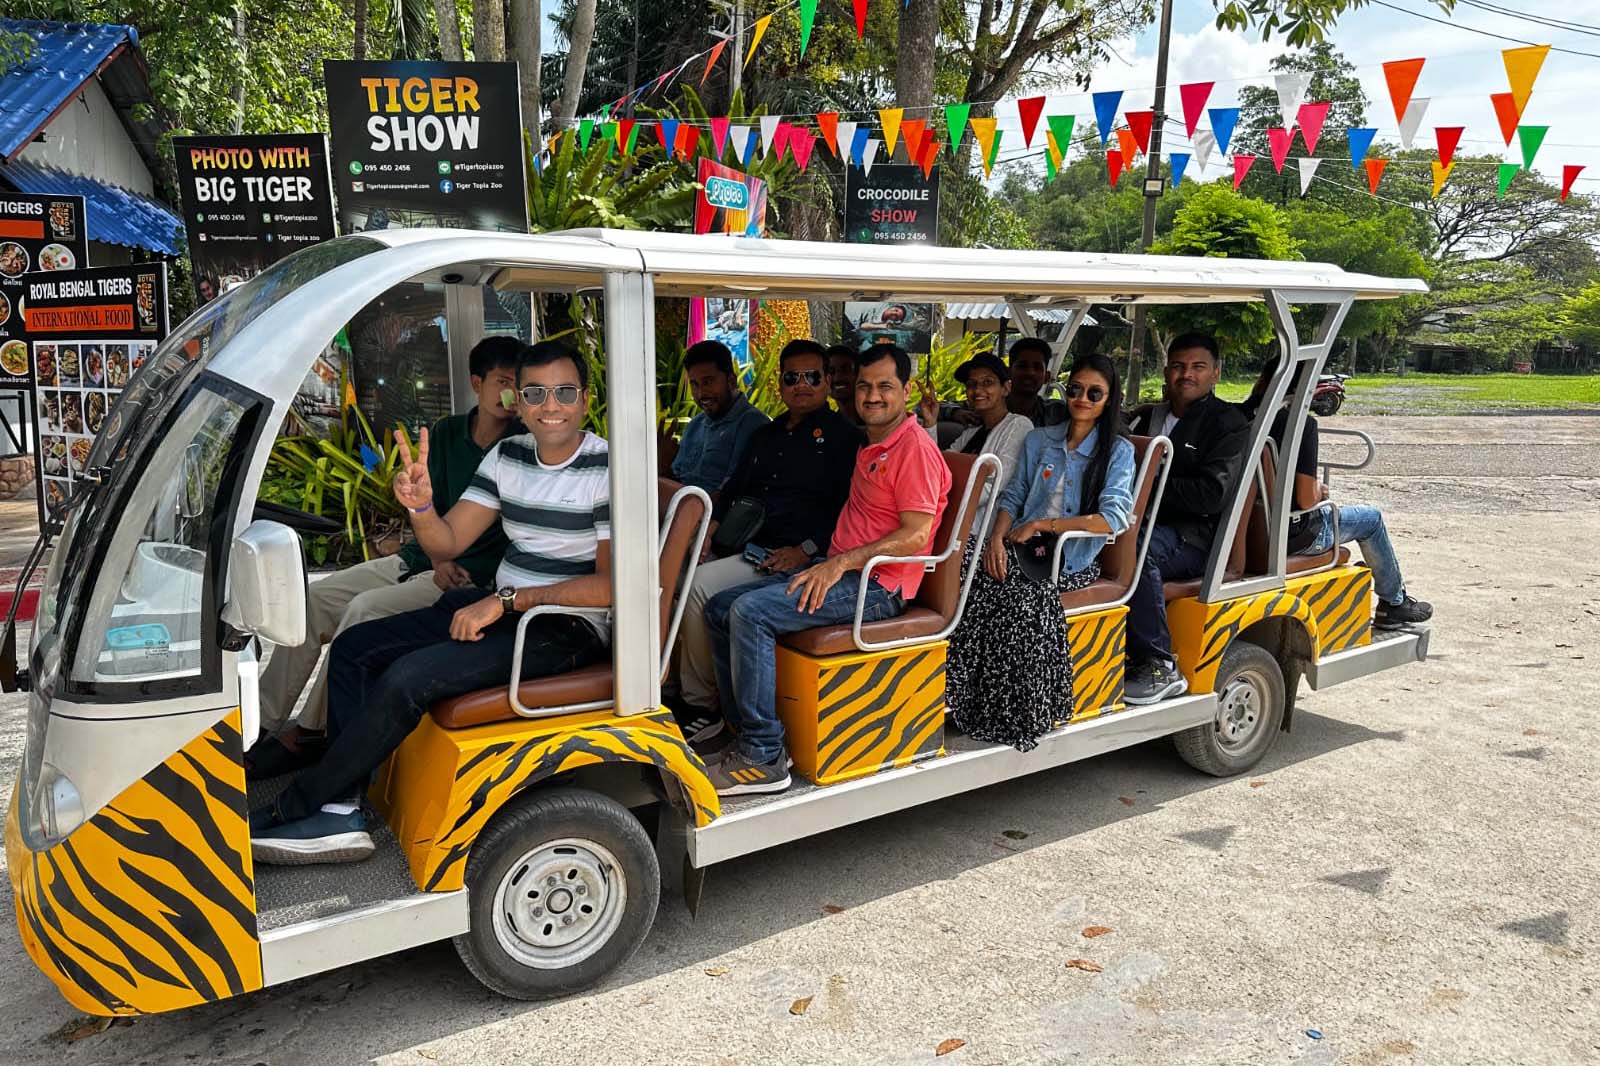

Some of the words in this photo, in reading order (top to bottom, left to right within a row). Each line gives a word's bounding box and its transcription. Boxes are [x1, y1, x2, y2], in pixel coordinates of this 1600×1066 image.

[360, 76, 481, 113] TIGER
[366, 114, 480, 152] SHOW
[190, 148, 254, 170] PHOTO
[258, 146, 310, 169] WITH
[194, 176, 236, 202] BIG
[242, 176, 314, 202] TIGER
[709, 180, 744, 206] Photo
[858, 188, 930, 200] CROCODILE
[0, 200, 44, 215] TIGERS
[871, 208, 918, 223] SHOW
[278, 234, 292, 242] Tiger
[30, 282, 58, 300] ROYAL
[60, 280, 96, 298] BENGAL
[97, 278, 132, 296] TIGERS
[32, 310, 100, 328] INTERNATIONAL
[104, 309, 130, 326] FOOD
